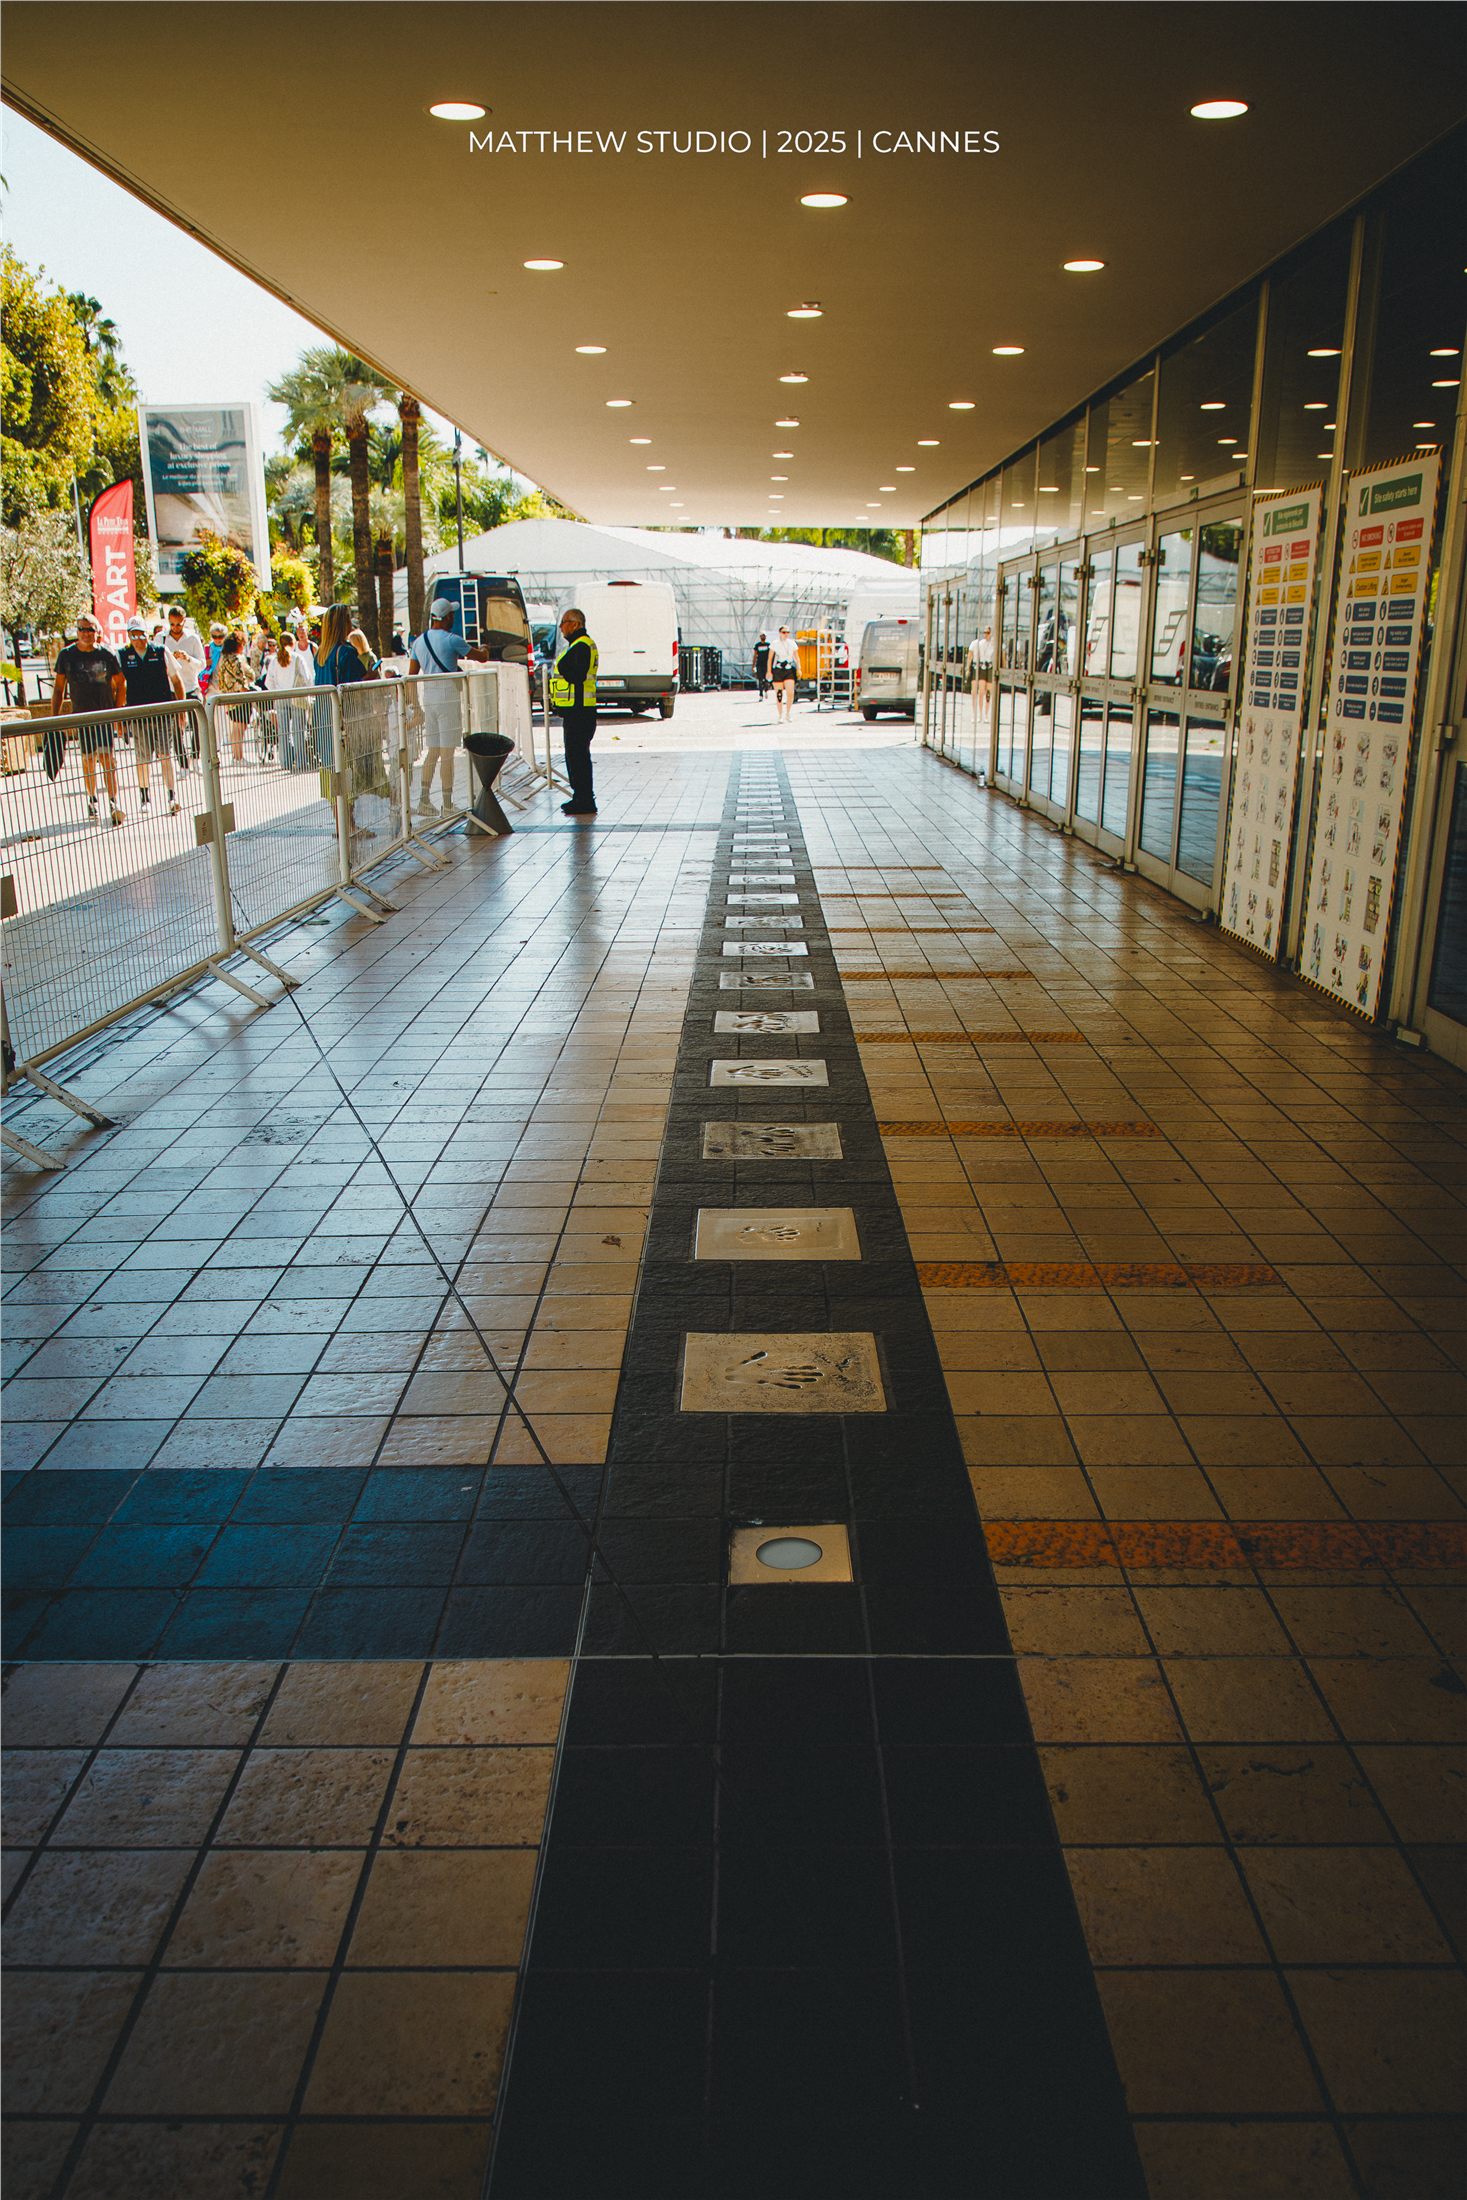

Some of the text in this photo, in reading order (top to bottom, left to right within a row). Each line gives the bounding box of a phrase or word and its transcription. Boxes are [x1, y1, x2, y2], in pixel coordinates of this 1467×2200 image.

[170, 452, 192, 462] luxury
[167, 462, 174, 470] at
[175, 461, 207, 470] exclusive
[1374, 486, 1418, 504] Site safety starts here
[104, 546, 129, 650] ÉPART
